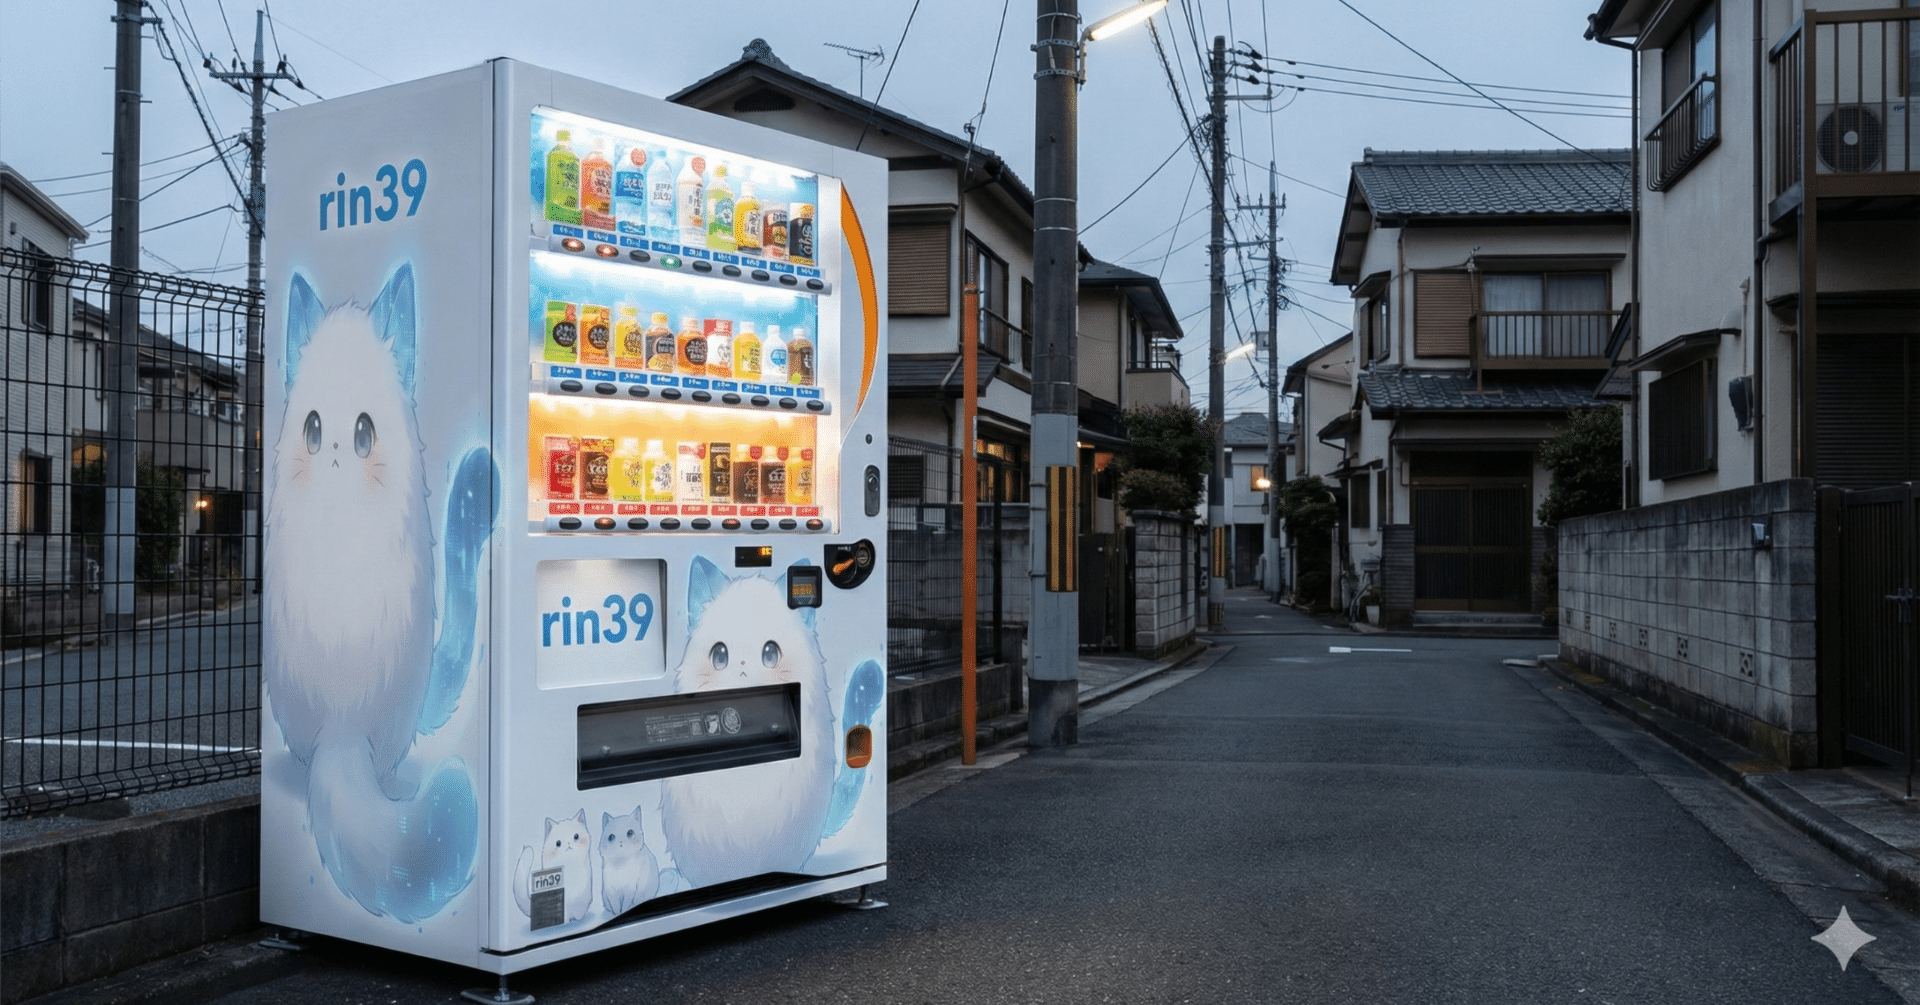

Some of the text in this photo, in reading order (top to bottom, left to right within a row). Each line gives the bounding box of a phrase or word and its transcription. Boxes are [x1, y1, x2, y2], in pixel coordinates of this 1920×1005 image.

[320, 158, 427, 231] rin39
[542, 593, 654, 647] rin39
[535, 874, 561, 889] rin39
